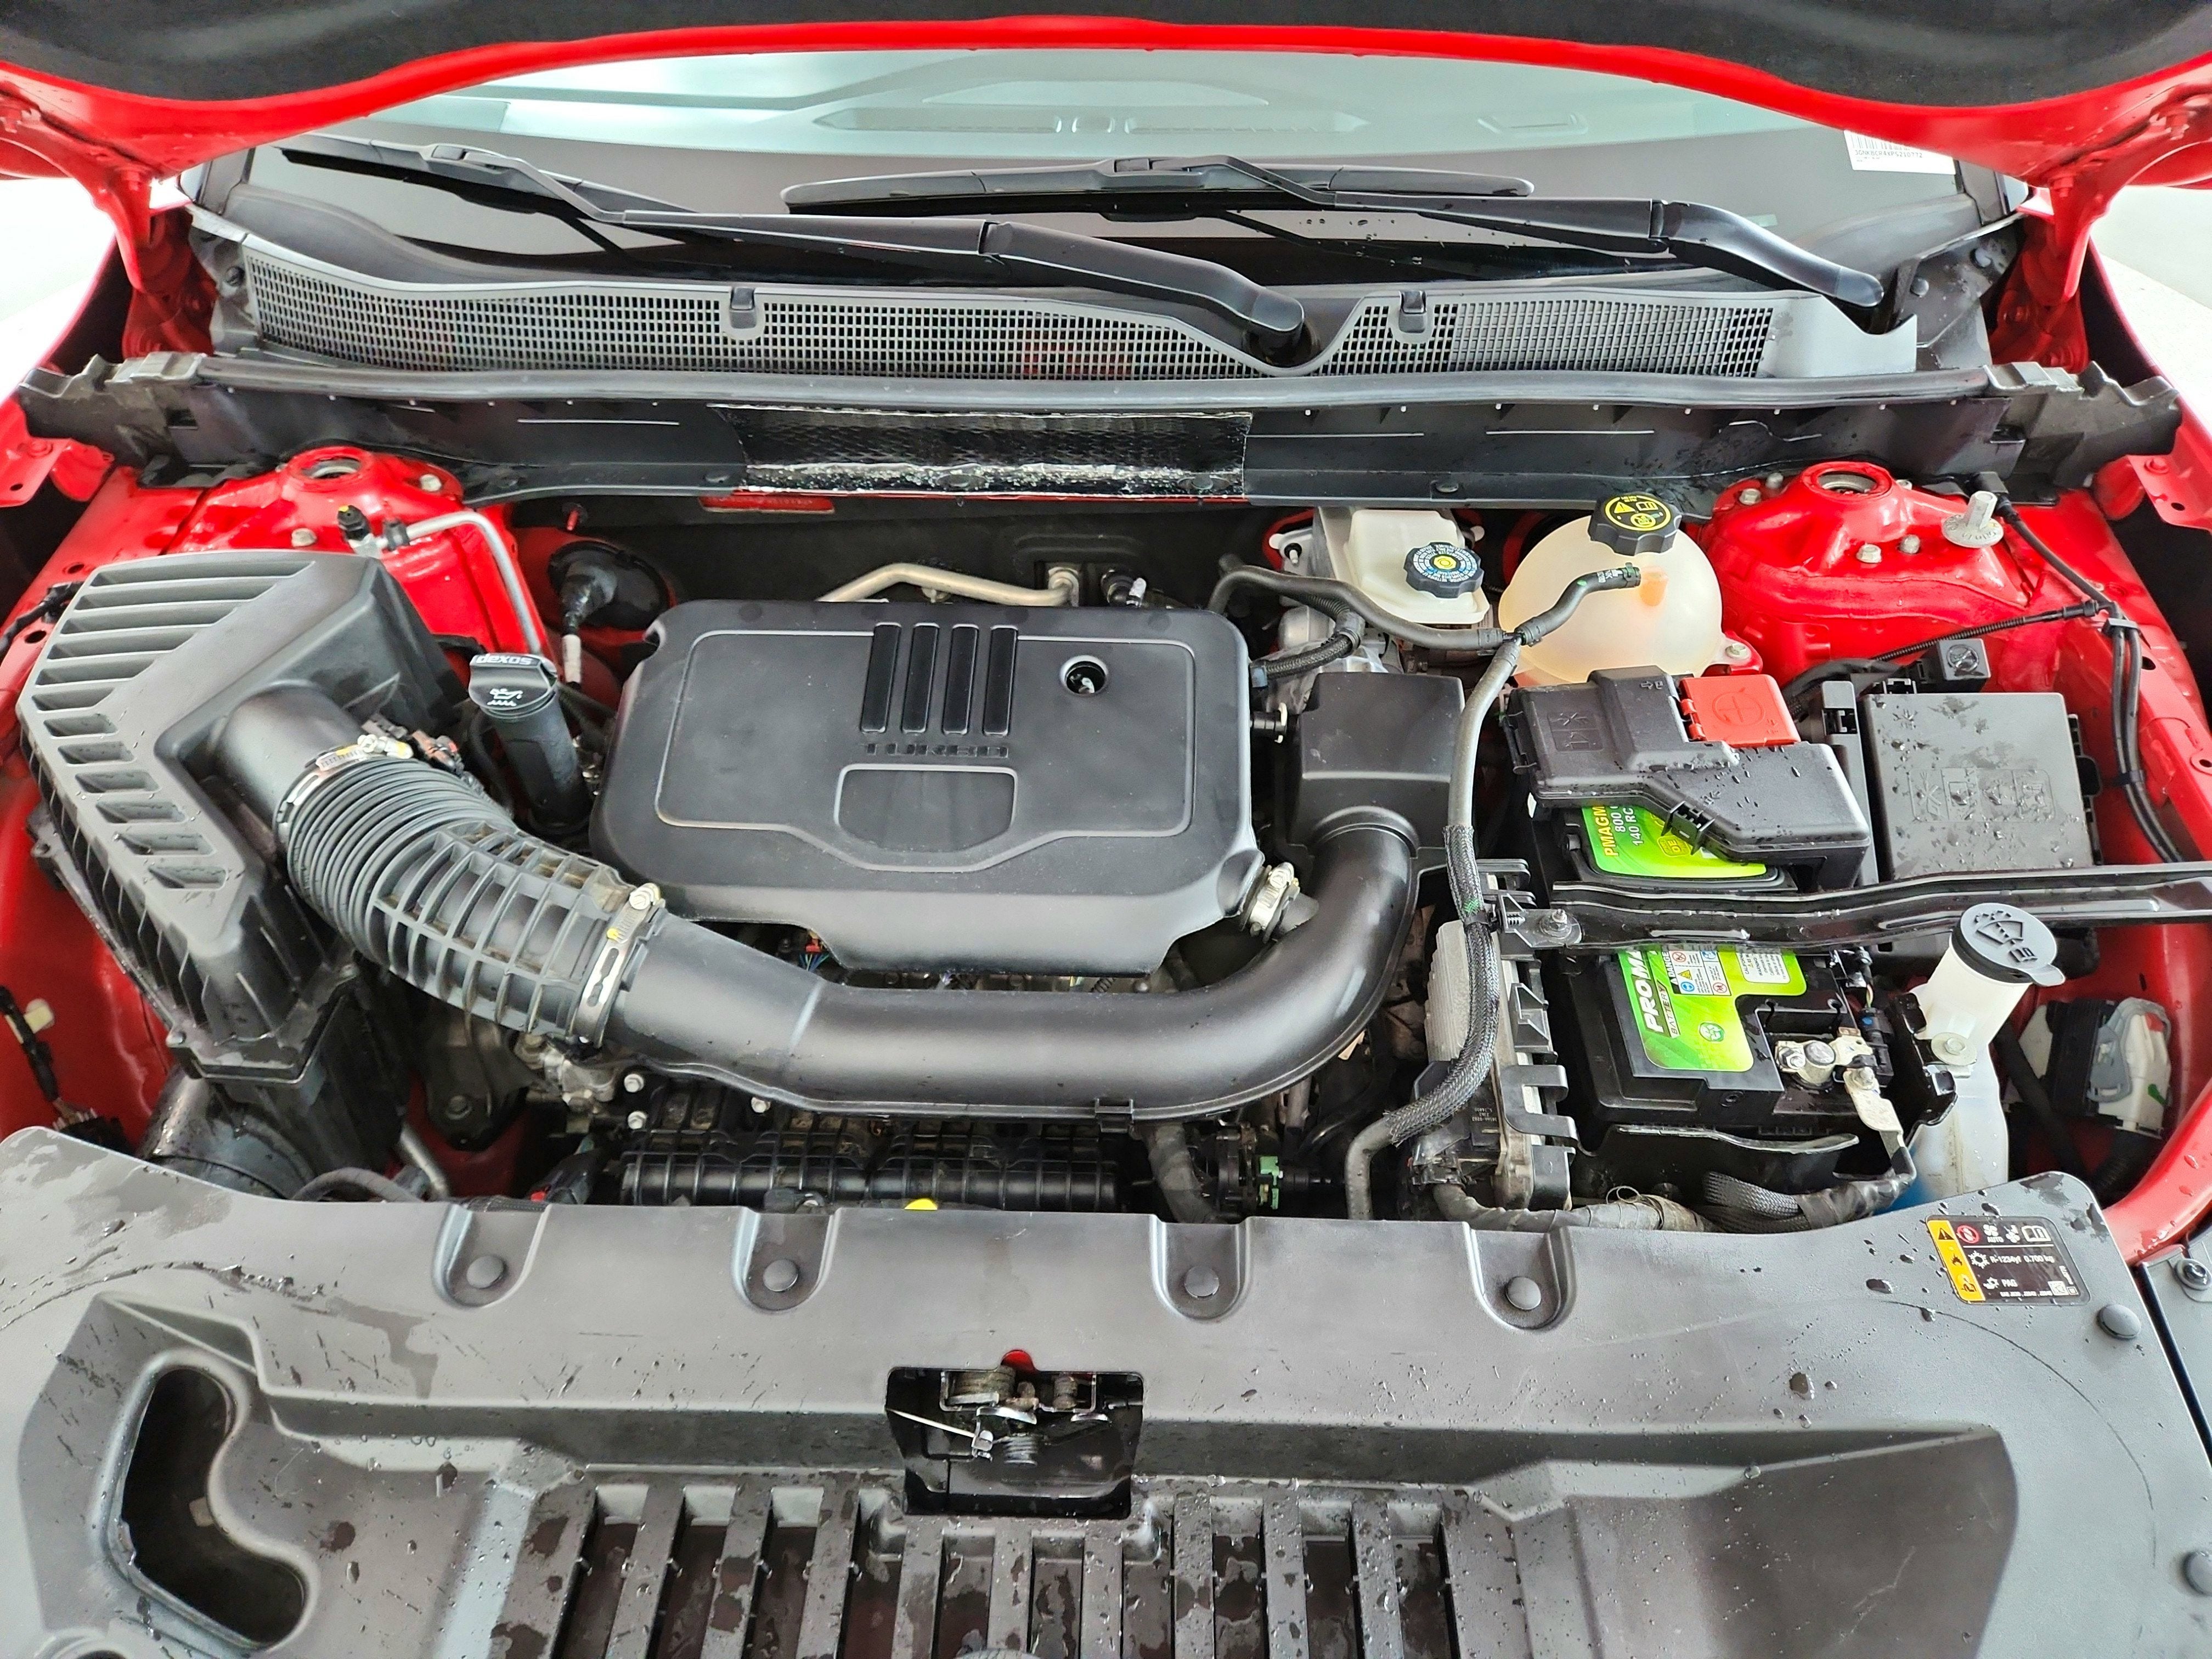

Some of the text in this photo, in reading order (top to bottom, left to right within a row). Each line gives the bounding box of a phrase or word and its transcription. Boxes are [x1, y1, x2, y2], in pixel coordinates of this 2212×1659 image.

[476, 653, 532, 665] dexos
[860, 743, 1009, 758] TURBO
[1611, 812, 1626, 832] 800
[1623, 808, 1644, 846] 140 RC
[1661, 951, 1675, 978] DANGE
[1658, 985, 1678, 1035] BATTERY
[1989, 1255, 2022, 1263] R-1234yf
[2001, 1279, 2018, 1287] PAG
